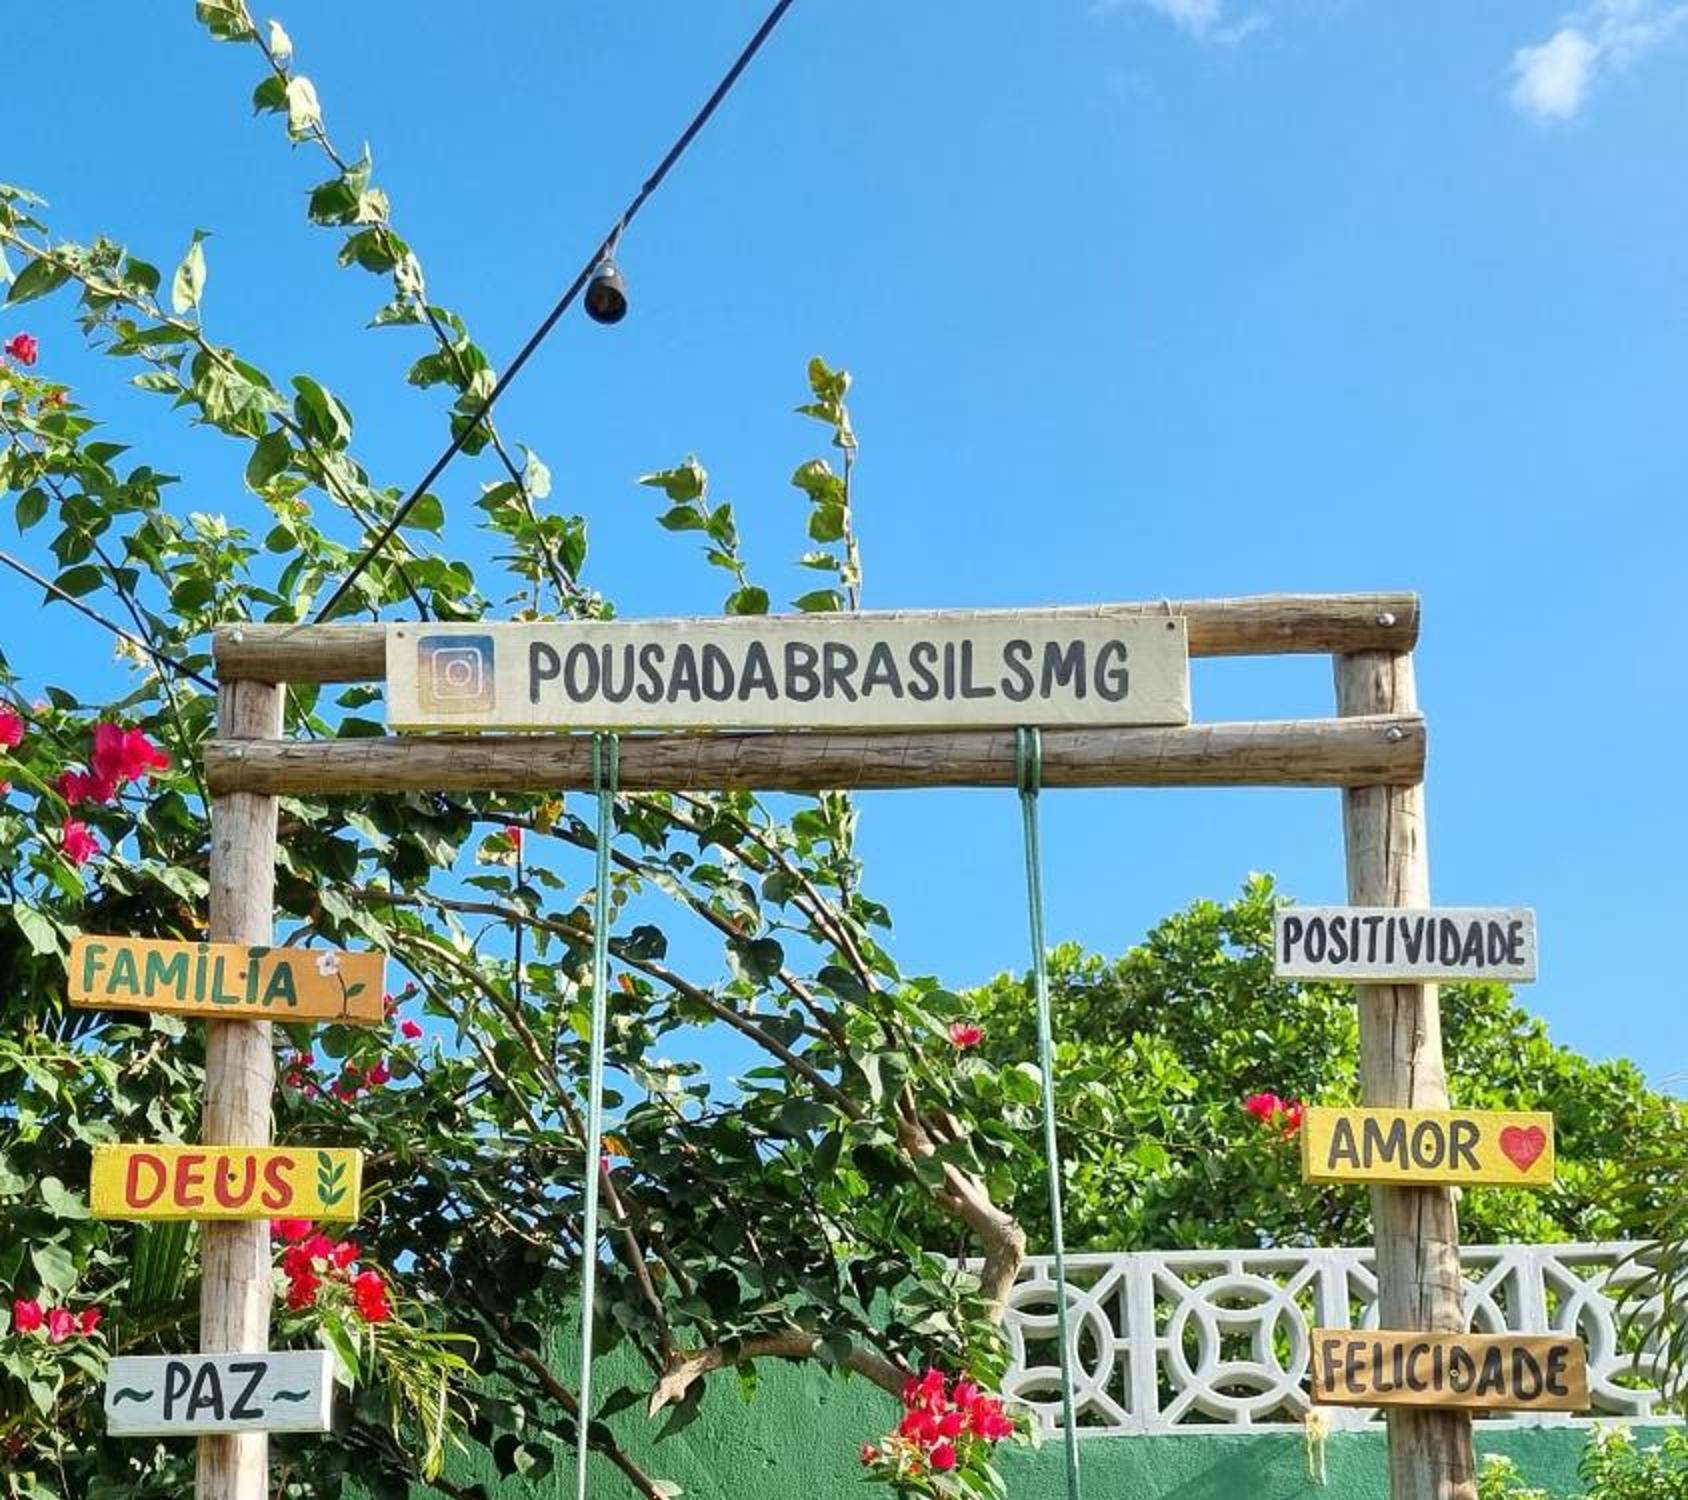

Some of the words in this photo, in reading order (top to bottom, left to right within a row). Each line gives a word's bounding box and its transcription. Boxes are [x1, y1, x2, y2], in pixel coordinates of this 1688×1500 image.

[529, 638, 1131, 704] POUSADABRASILSMG
[1282, 915, 1525, 967] POSITIVIDADE
[1327, 1117, 1482, 1171] AMOR
[125, 1153, 295, 1210] DEUS
[163, 1361, 268, 1421] PAZ
[1321, 1339, 1569, 1401] FELICIDADE
